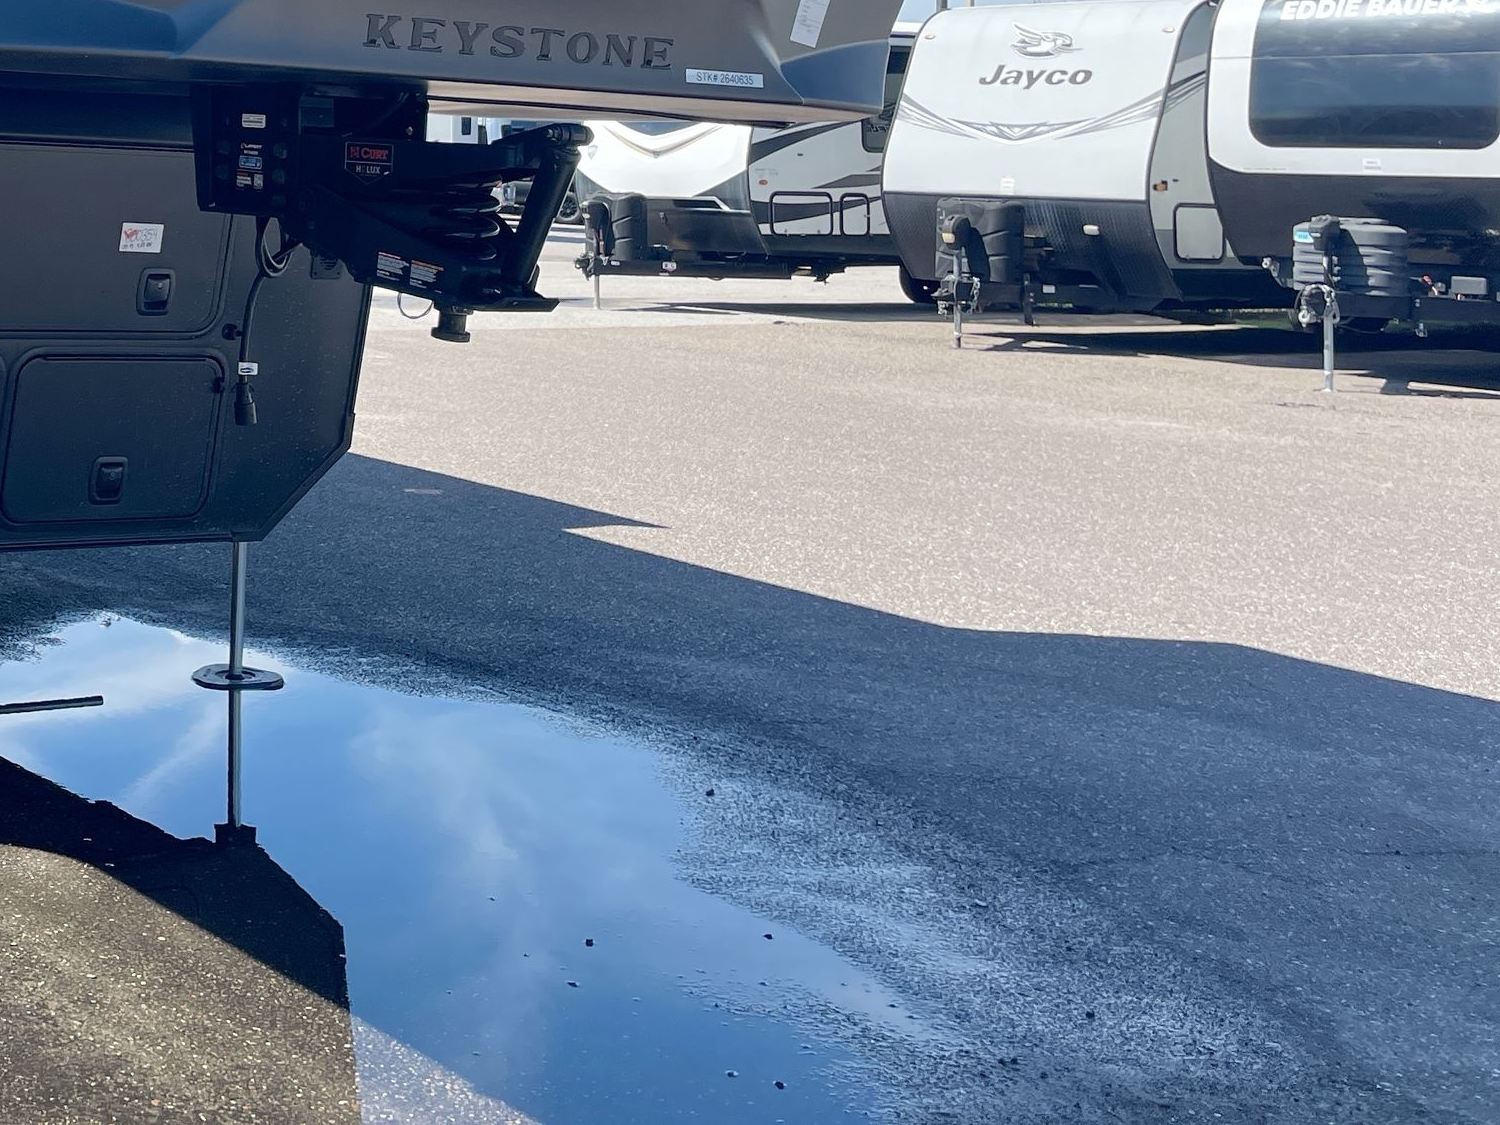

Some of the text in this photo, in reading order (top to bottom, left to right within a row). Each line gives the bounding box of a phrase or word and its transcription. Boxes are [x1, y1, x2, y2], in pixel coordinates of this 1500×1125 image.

[362, 13, 675, 70] KEYSTONE
[695, 71, 754, 85] STK# 2640635
[978, 64, 1093, 90] Jayco
[361, 147, 389, 160] CURT
